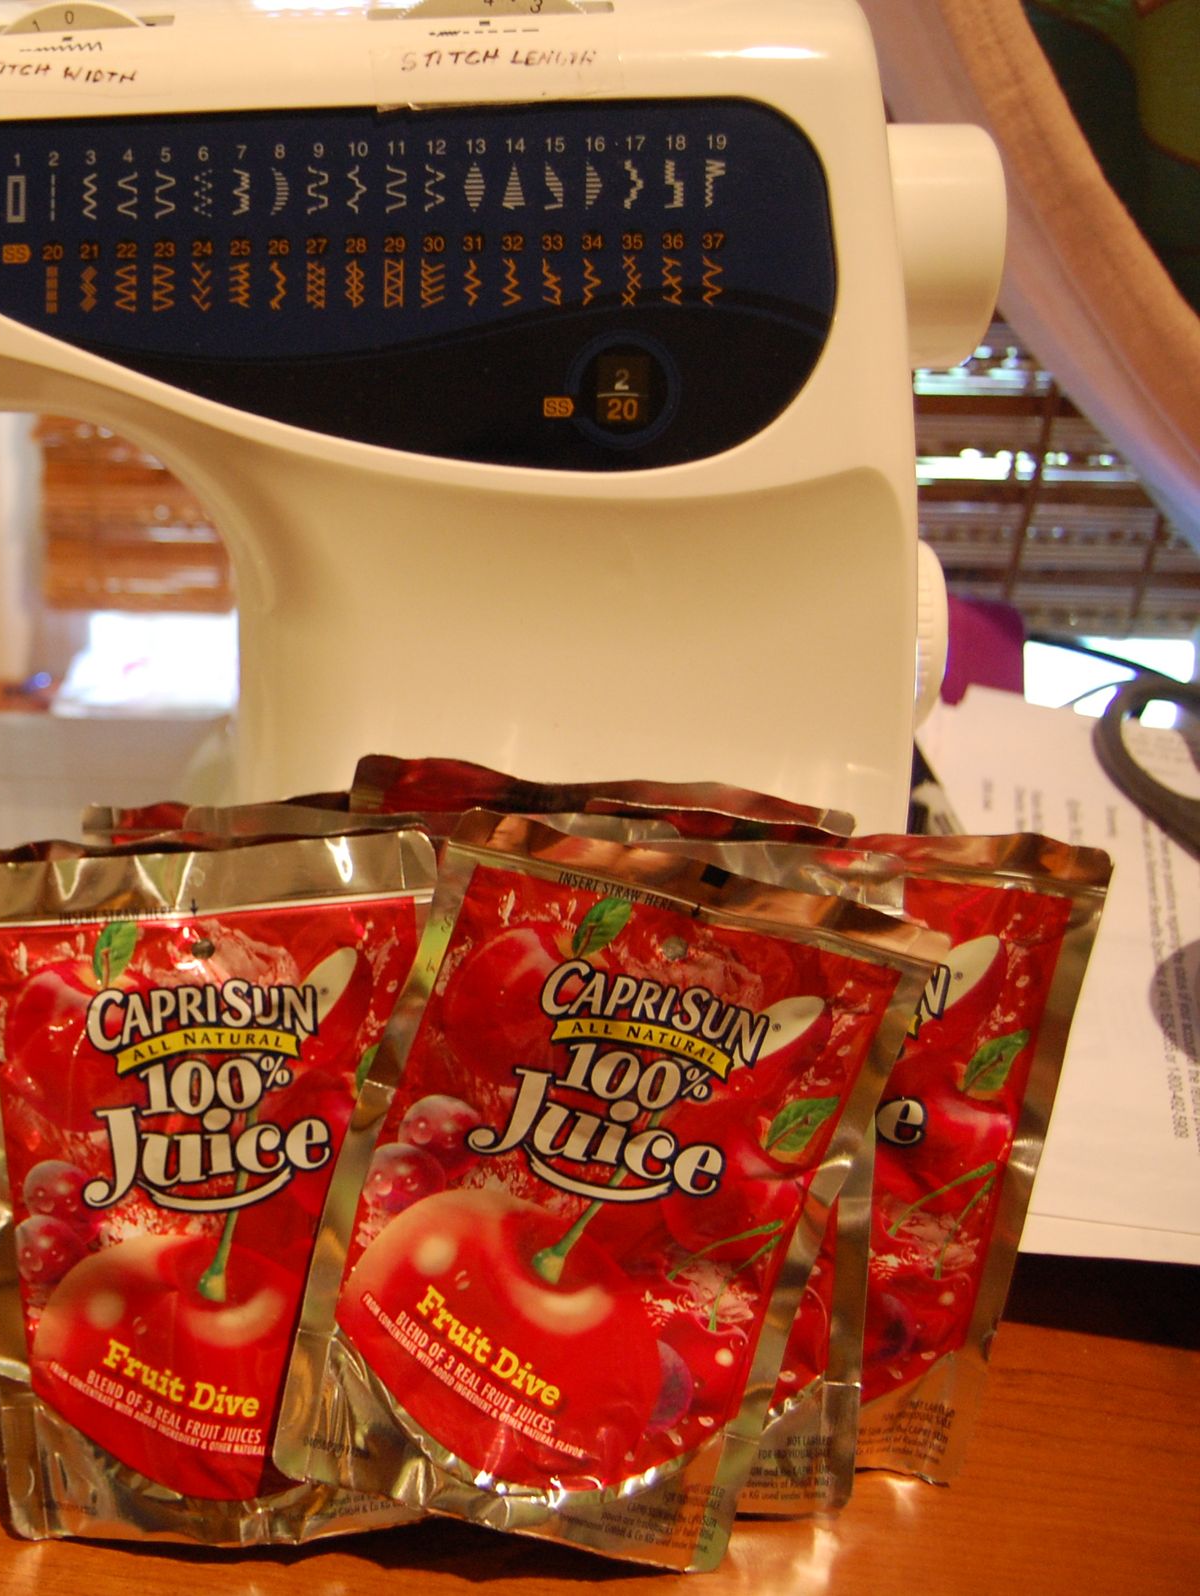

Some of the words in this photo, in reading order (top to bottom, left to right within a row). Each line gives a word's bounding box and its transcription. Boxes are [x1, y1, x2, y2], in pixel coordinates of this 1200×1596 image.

[64, 10, 75, 25] 0
[63, 66, 139, 84] WIDTH
[401, 48, 501, 71] STITCH
[48, 151, 60, 167] 2
[86, 150, 97, 165] 3
[123, 148, 133, 163] 4
[160, 147, 171, 163] 5
[197, 146, 209, 162] 6
[236, 144, 247, 159] 7
[274, 143, 286, 159] 8
[313, 142, 324, 158] 9
[348, 141, 369, 157] 10
[388, 141, 405, 155] 11
[427, 139, 446, 155] 12
[466, 138, 486, 154] 13
[506, 137, 525, 153] 14
[546, 137, 565, 153] 15
[586, 136, 606, 152] 16
[626, 135, 646, 151] 17
[667, 135, 686, 151] 18
[707, 134, 727, 150] 19
[42, 244, 64, 261] 20
[80, 243, 99, 259] 21
[116, 243, 137, 258] 22
[154, 242, 175, 257] 23
[192, 241, 213, 257] 24
[230, 240, 251, 256] 25
[269, 239, 289, 255] 26
[306, 238, 328, 255] 27
[345, 238, 367, 253] 28
[384, 237, 406, 253] 29
[423, 236, 445, 252] 30
[463, 235, 482, 251] 31
[502, 235, 523, 251] 32
[542, 235, 564, 251] 33
[582, 235, 602, 250] 34
[622, 234, 643, 250] 35
[662, 234, 684, 249] 36
[702, 233, 724, 249] 37
[614, 368, 630, 391] 2
[607, 399, 639, 421] 20
[559, 871, 600, 892] INSERT
[603, 883, 641, 902] STRAW
[133, 1040, 161, 1062] ALL
[183, 1028, 285, 1049] NATURAL
[571, 1022, 614, 1037] ALL
[626, 1025, 717, 1067] NATURAL
[139, 1055, 292, 1118] 100%
[555, 1042, 714, 1113] 100%
[467, 1066, 725, 1196] Juice
[82, 1105, 332, 1209] Juice
[362, 1292, 381, 1317] FROM
[416, 1285, 492, 1363] Fruit
[490, 1346, 561, 1406] Dive
[103, 1338, 186, 1404] Fruit
[189, 1381, 261, 1419] Dive
[395, 1310, 430, 1348] BLEND
[428, 1341, 447, 1362] OF
[444, 1354, 456, 1371] 3
[453, 1362, 482, 1392] REAL
[480, 1382, 516, 1412] FRUIT
[513, 1403, 556, 1434] JUICES
[86, 1369, 125, 1400] BLEND
[125, 1389, 145, 1408] OF
[144, 1399, 155, 1415] 3
[154, 1406, 182, 1431] REAL
[184, 1418, 222, 1441] FRUIT
[221, 1427, 263, 1445] JUICES
